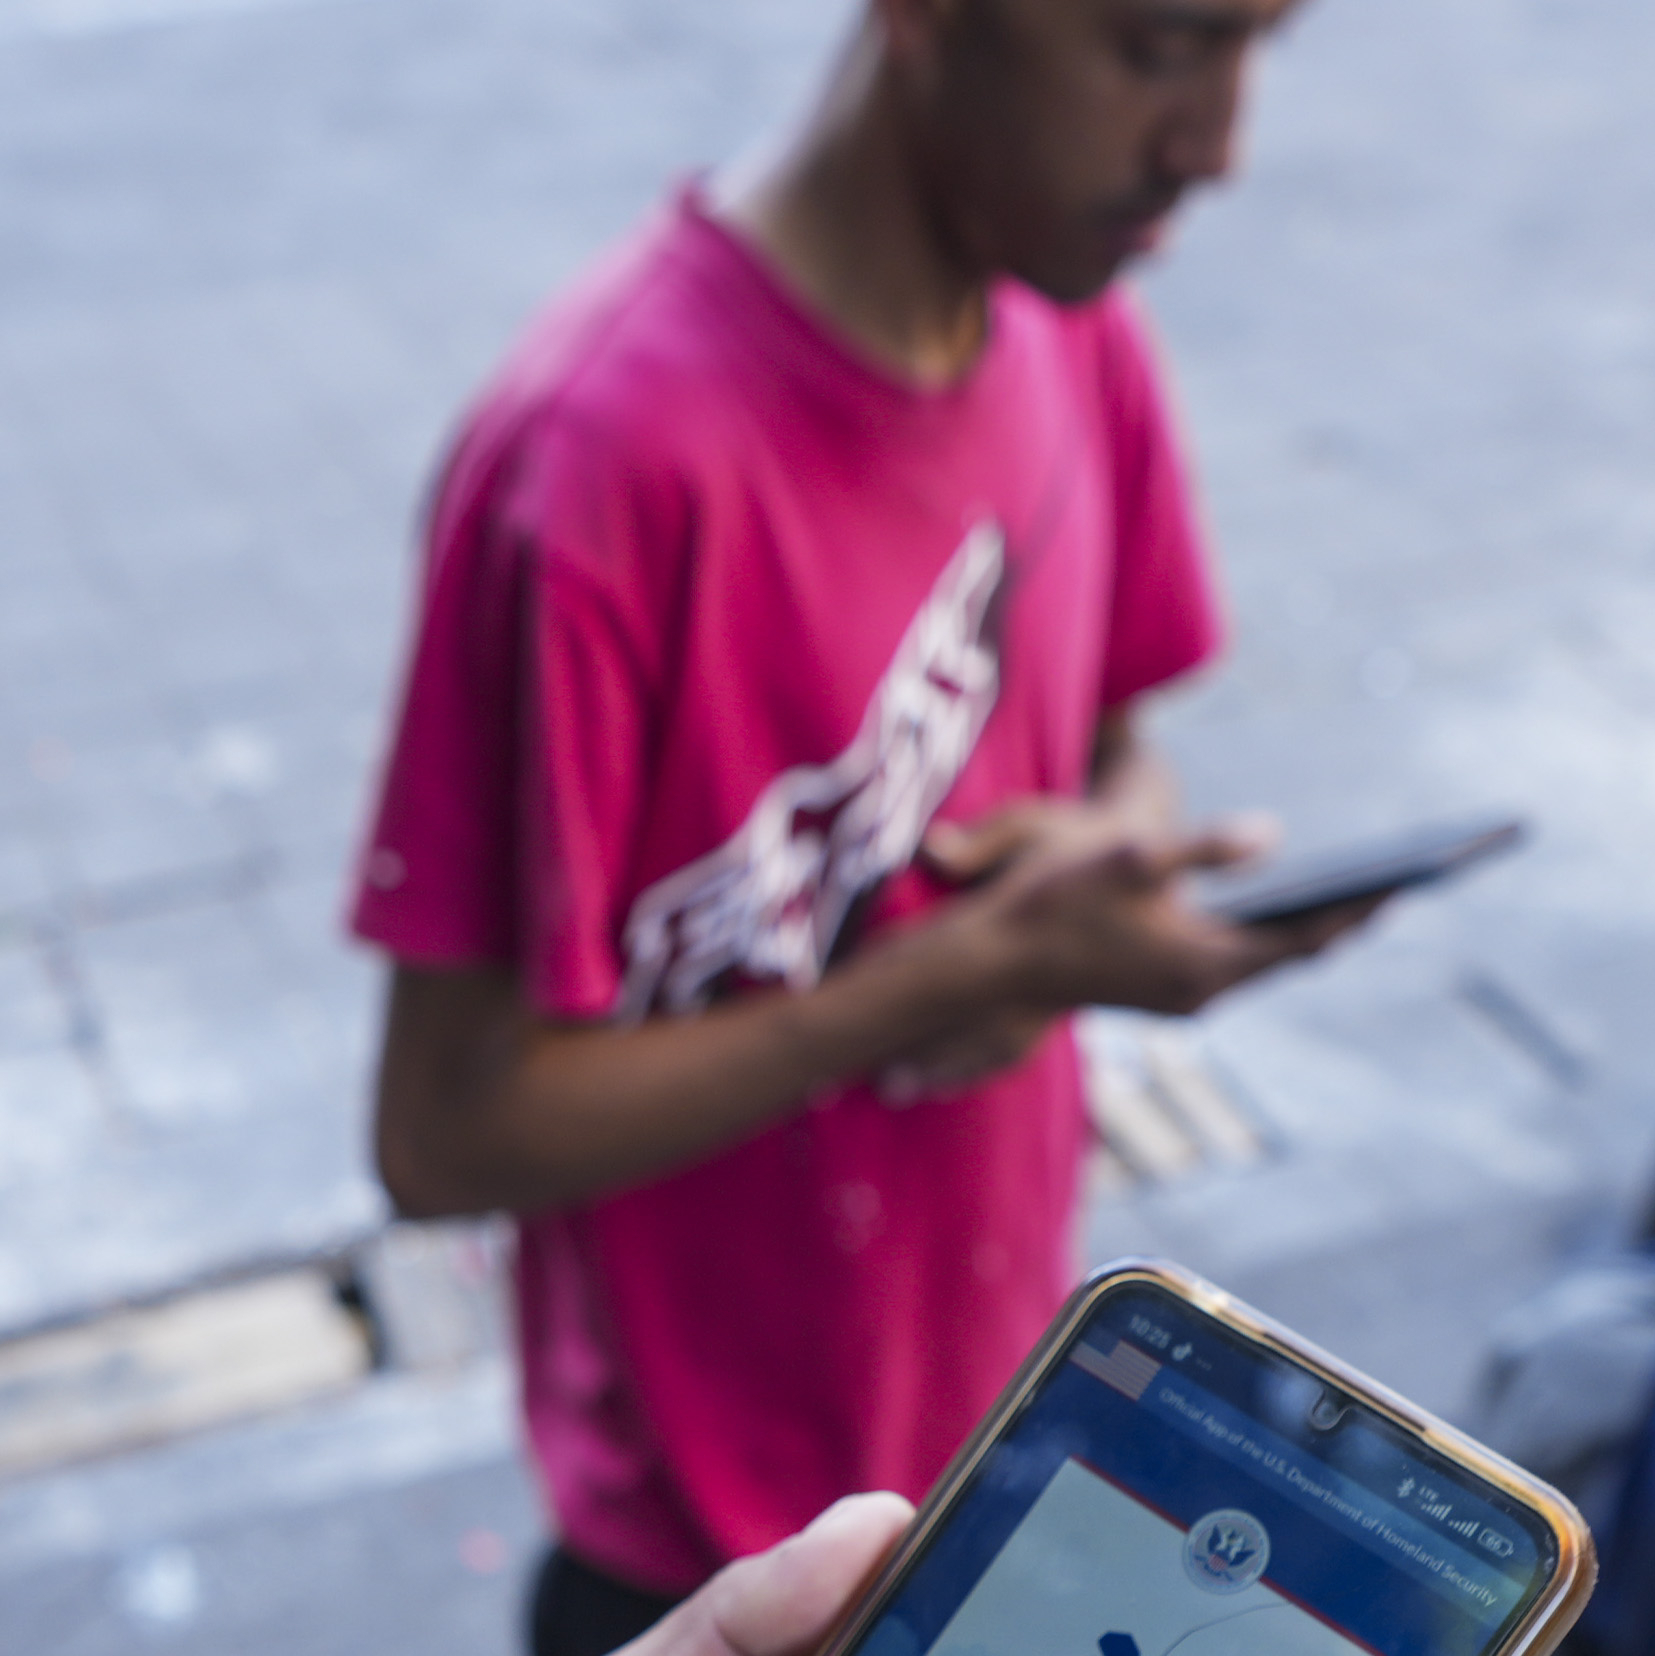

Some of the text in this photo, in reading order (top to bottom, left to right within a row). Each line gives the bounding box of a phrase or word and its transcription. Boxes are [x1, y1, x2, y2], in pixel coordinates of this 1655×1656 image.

[1243, 1438, 1264, 1460] the
[1287, 1466, 1363, 1523] Department
[1361, 1516, 1379, 1531] of
[1376, 1524, 1445, 1573] Homeland
[1441, 1564, 1498, 1607] Security
